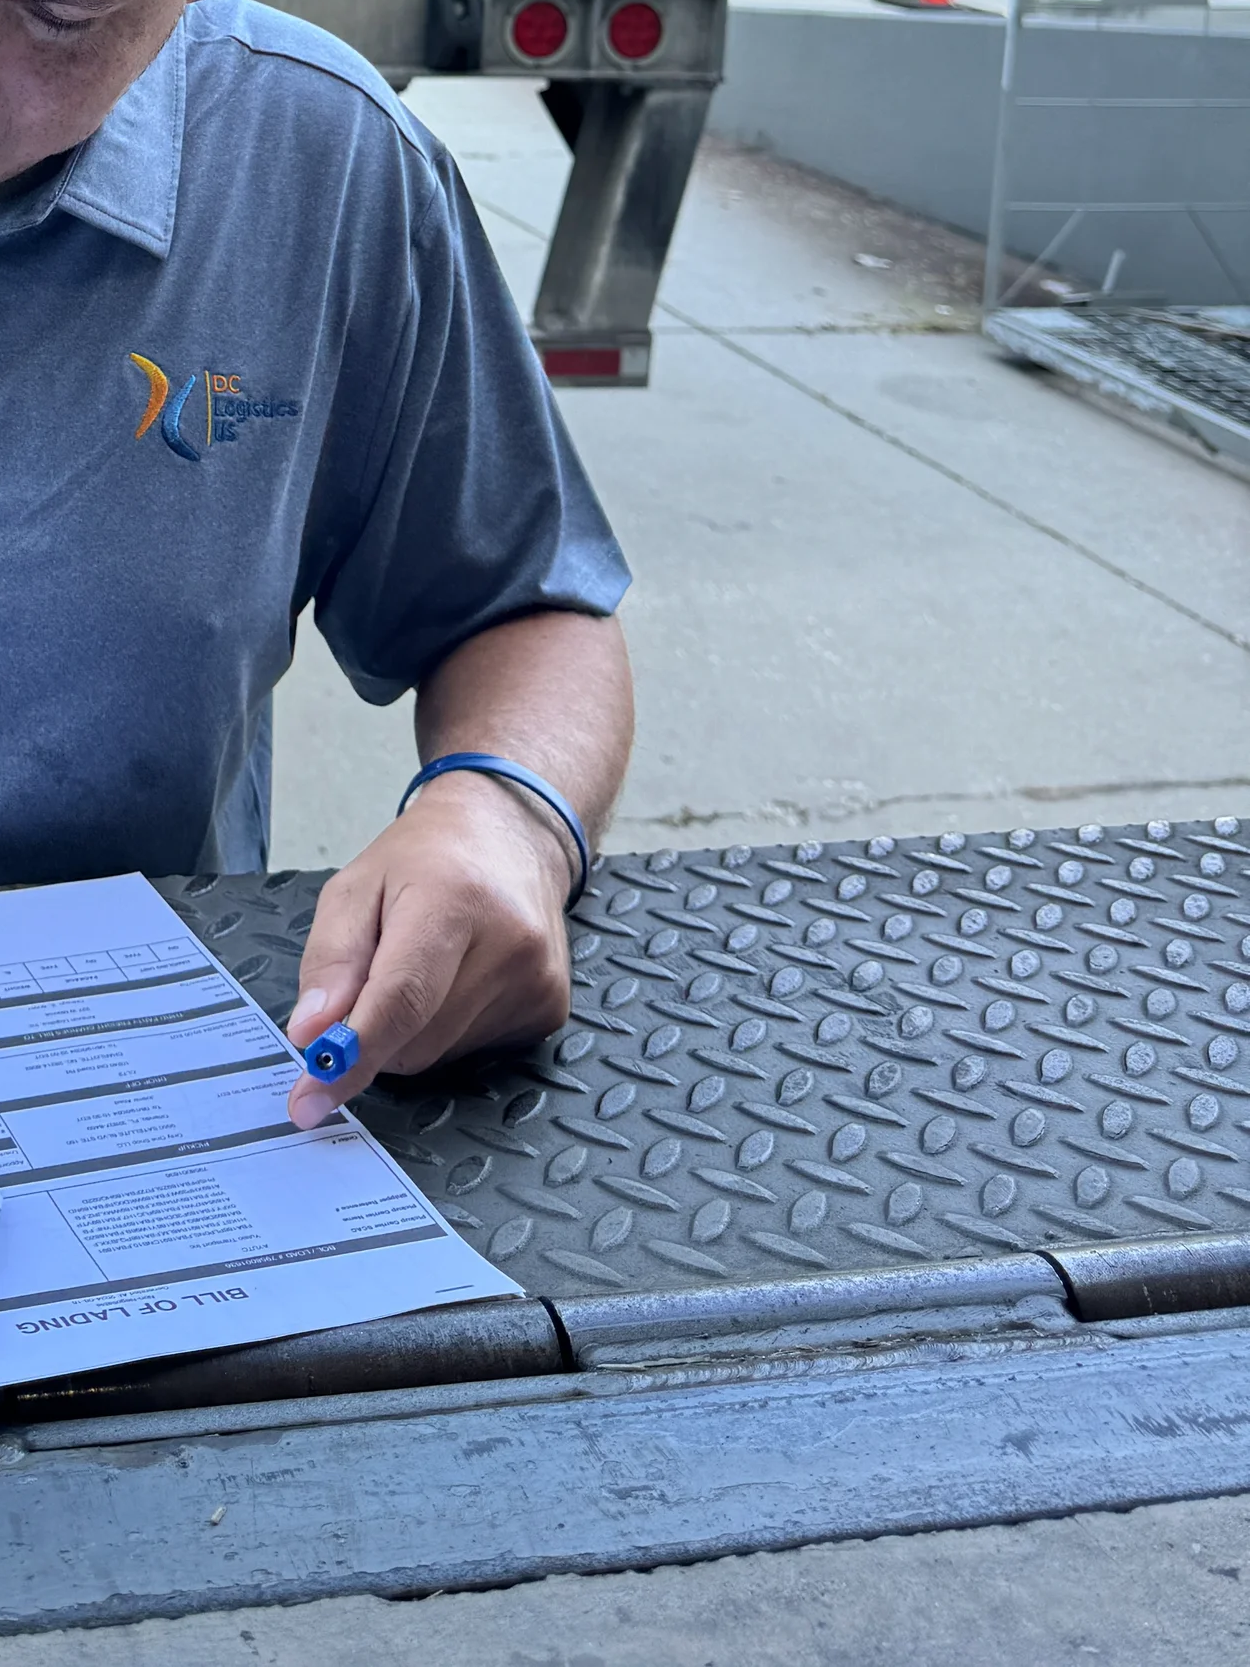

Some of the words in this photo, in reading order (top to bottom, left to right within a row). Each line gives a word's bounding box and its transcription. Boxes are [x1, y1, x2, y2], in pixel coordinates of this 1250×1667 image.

[212, 375, 242, 394] DC
[214, 397, 299, 423] Logistics
[214, 422, 238, 443] US
[134, 1298, 179, 1315] OF
[179, 1286, 249, 1308] BILL
[14, 1304, 131, 1335] LADING
